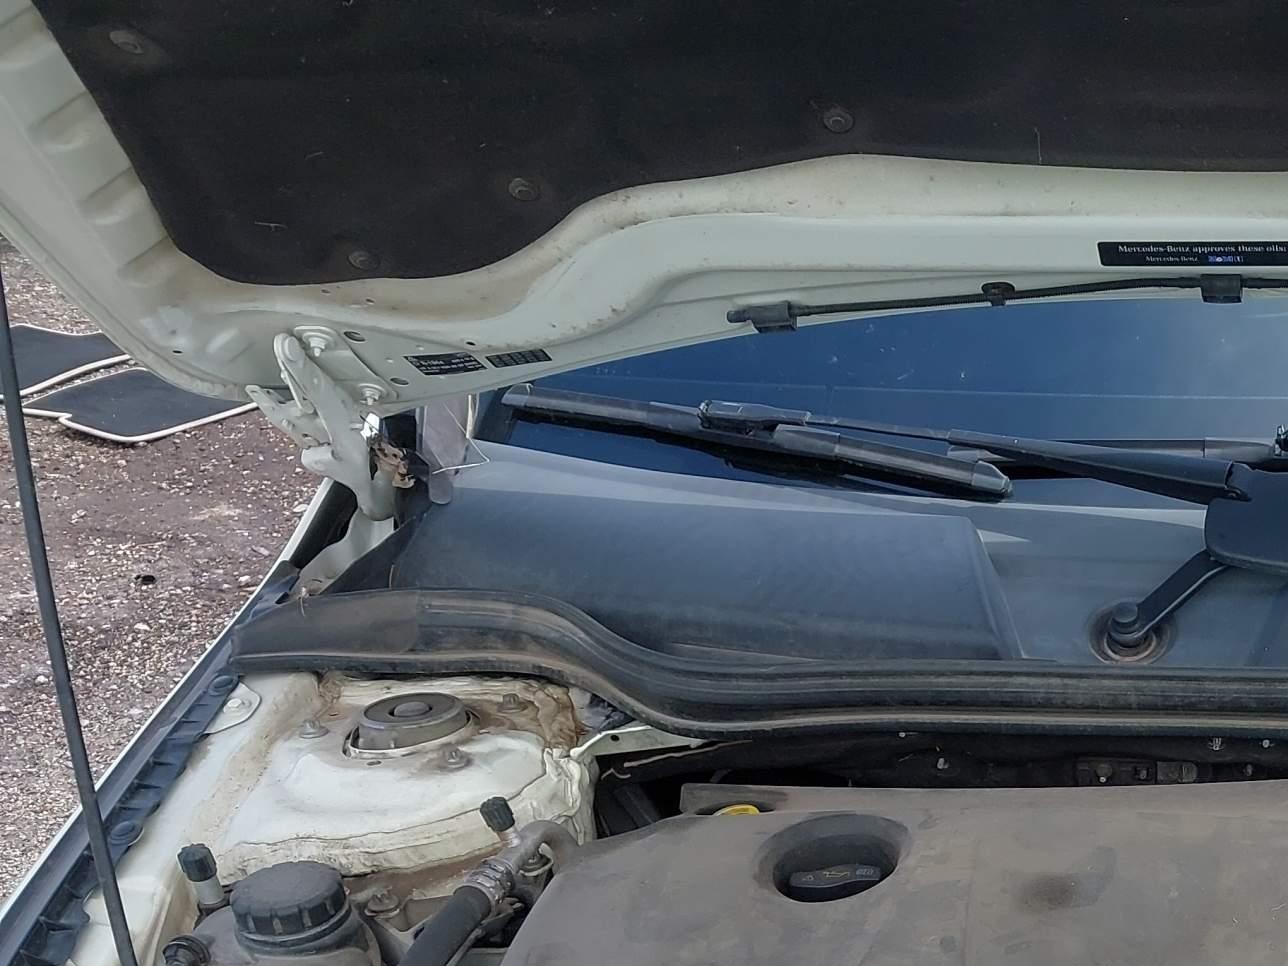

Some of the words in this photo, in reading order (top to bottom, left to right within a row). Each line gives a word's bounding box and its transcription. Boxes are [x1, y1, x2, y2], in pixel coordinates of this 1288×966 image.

[1118, 245, 1191, 253] Mercedes-Benz
[1192, 245, 1236, 254] approves
[1238, 245, 1264, 253] these
